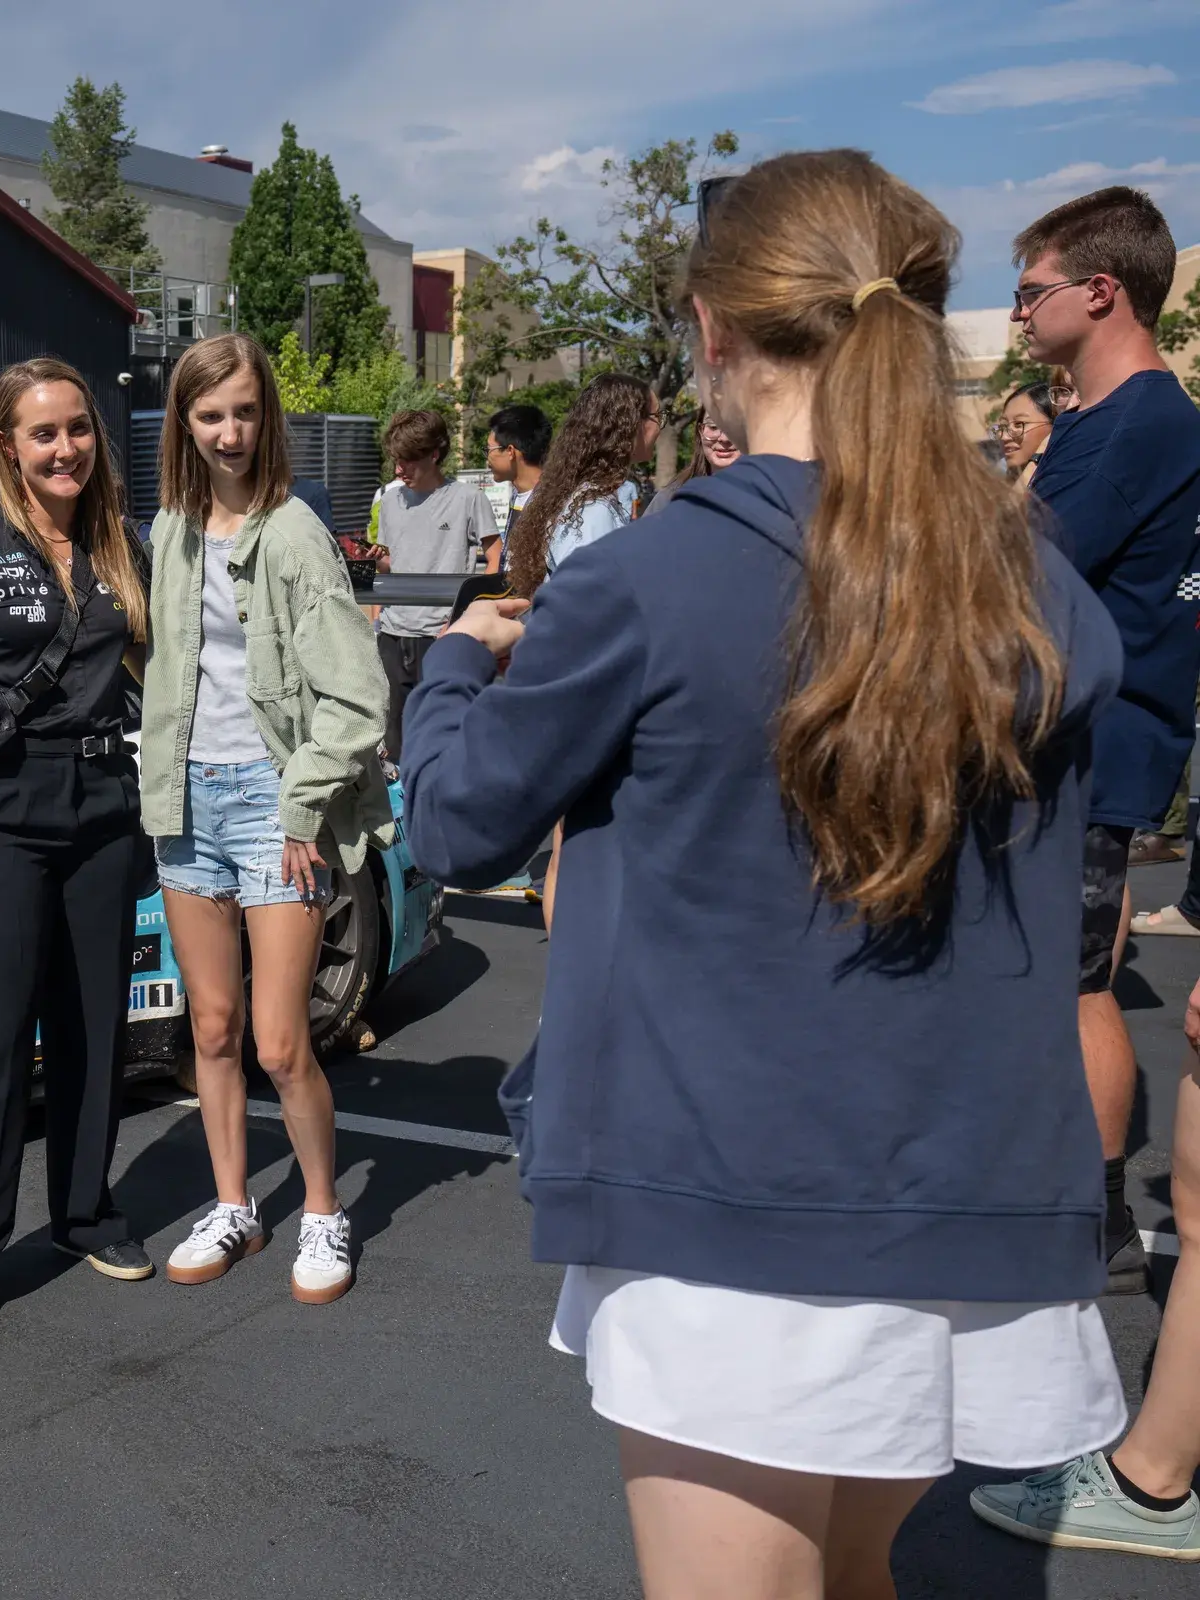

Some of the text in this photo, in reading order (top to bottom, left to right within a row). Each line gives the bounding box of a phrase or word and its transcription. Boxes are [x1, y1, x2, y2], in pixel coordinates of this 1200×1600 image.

[10, 606, 46, 616] COTTON
[28, 613, 47, 623] SOX
[155, 984, 165, 1007] 1
